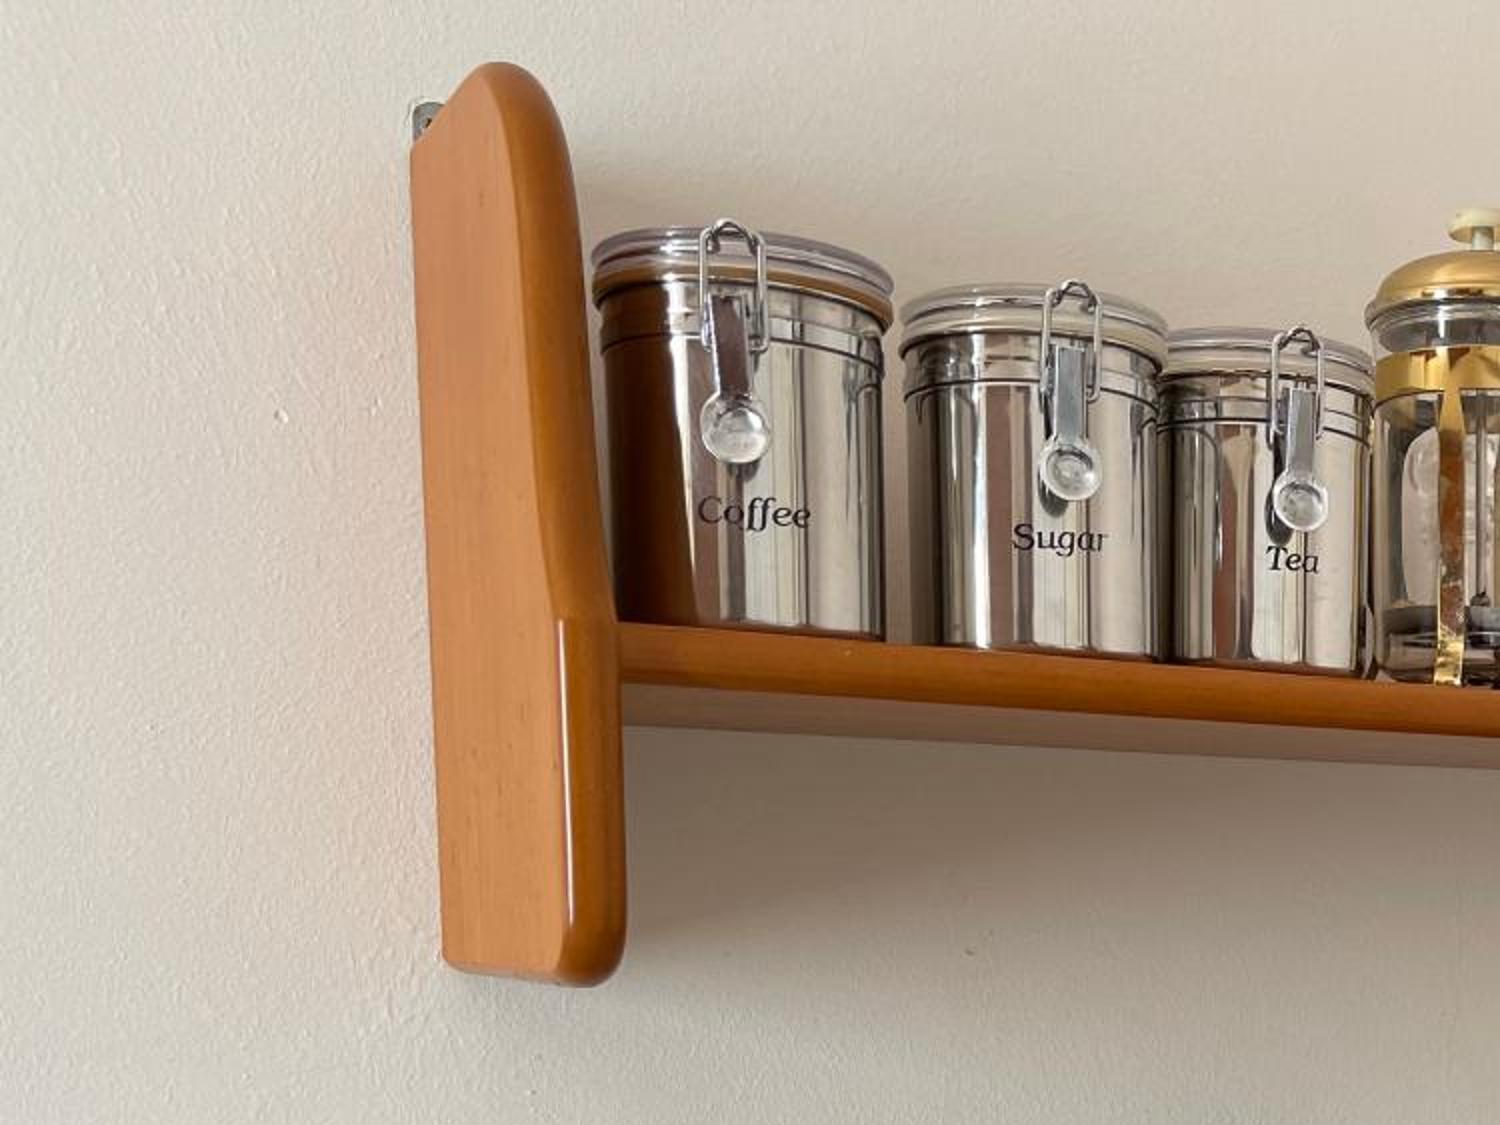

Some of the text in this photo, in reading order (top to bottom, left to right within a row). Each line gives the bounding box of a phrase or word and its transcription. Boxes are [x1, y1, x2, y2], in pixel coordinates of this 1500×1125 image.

[698, 495, 811, 532] Coffee
[1011, 523, 1109, 557] Sugar
[1265, 545, 1319, 574] Tea
